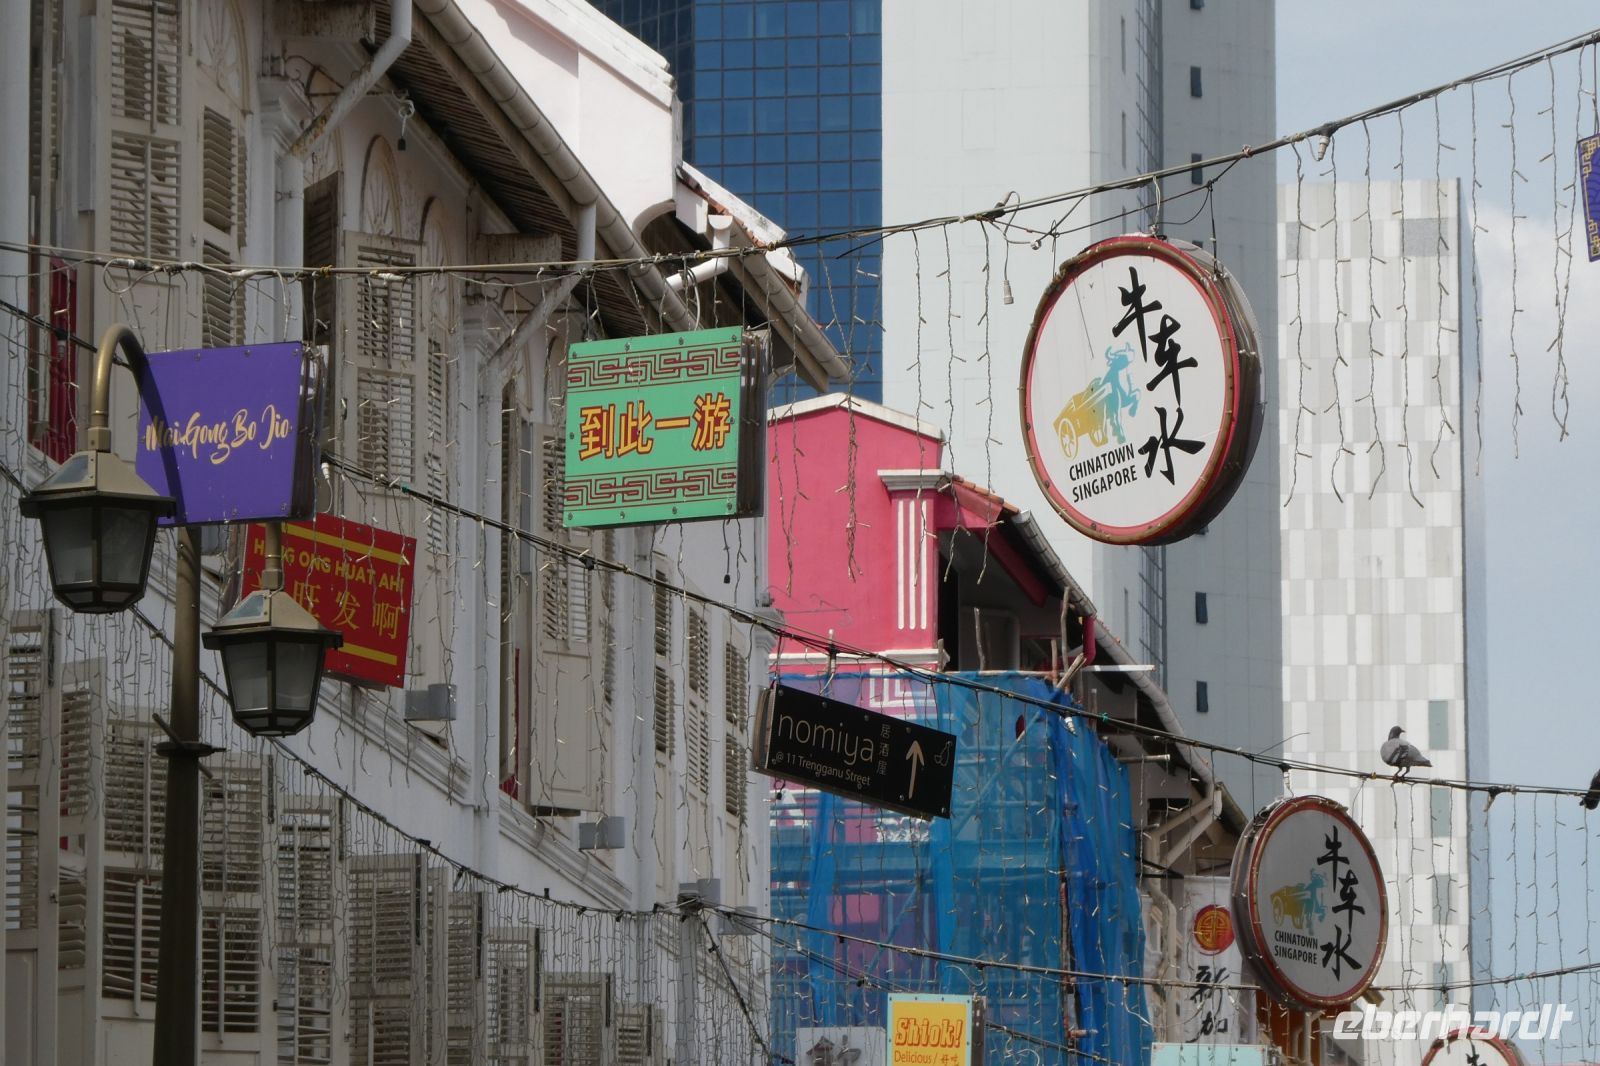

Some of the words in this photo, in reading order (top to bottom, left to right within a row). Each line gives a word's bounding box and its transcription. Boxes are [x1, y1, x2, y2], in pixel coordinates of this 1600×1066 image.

[144, 416, 180, 451] Mai
[180, 411, 230, 465] Gong
[231, 408, 257, 448] Bo
[259, 404, 290, 450] Jio
[579, 392, 731, 461] 到此一游
[1069, 443, 1135, 481] CHINATOWN
[1072, 465, 1138, 503] SINGAPORE
[254, 538, 295, 564] HNG
[299, 551, 331, 573] ONG
[335, 560, 376, 585] HUAT
[250, 571, 401, 640] 旺发啊
[777, 714, 875, 766] nomiya
[787, 753, 796, 766] 11
[798, 756, 844, 778] Trengganu
[845, 769, 871, 786] Street
[1274, 930, 1319, 950] CHINATOWN
[1274, 944, 1318, 965] SINGAPORE
[895, 1017, 964, 1048] Shiok!
[894, 1050, 932, 1065] Delicious
